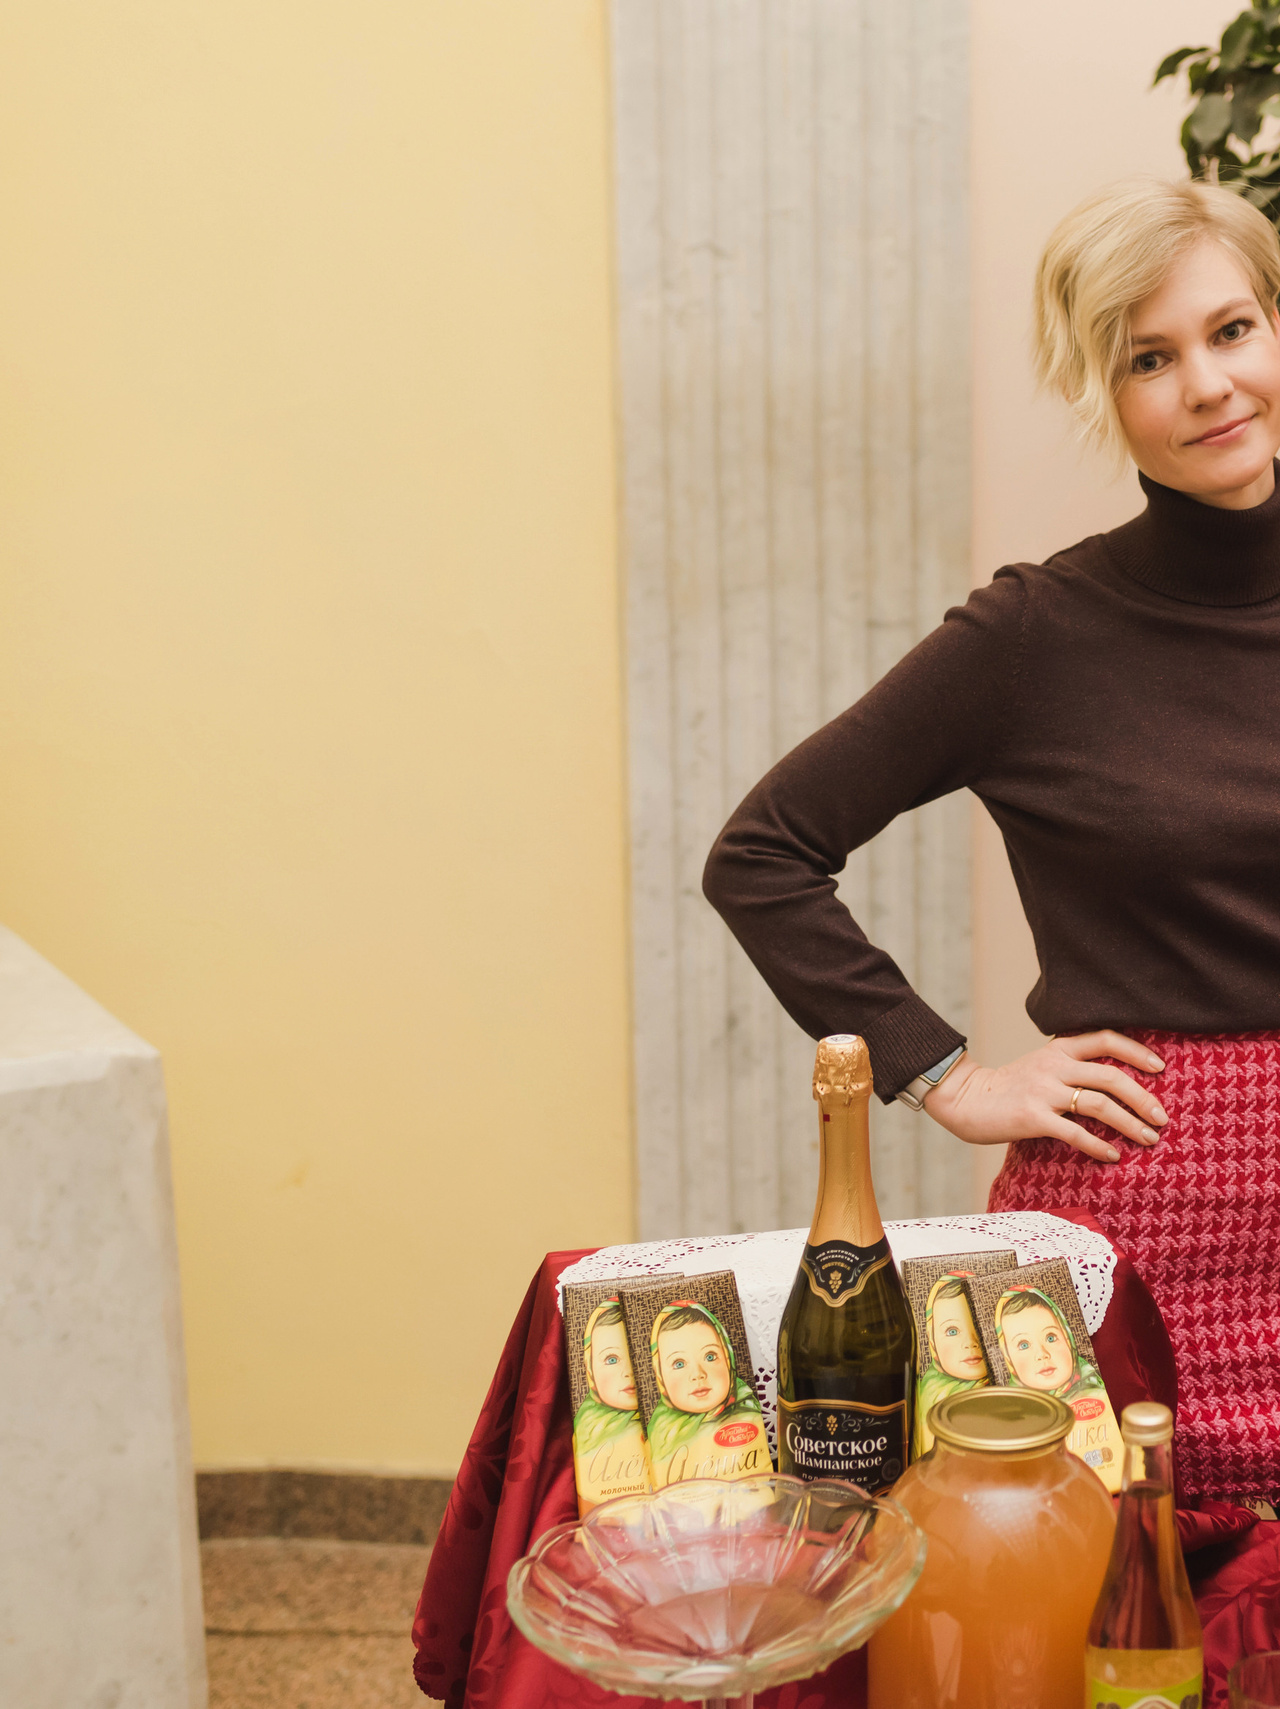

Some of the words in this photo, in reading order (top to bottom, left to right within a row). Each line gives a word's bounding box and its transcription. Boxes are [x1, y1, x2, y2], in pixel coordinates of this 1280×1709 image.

[588, 1439, 647, 1484] Алё
[802, 1473, 868, 1482] ПОЛДКОЕ
[600, 1482, 645, 1496] молочный
